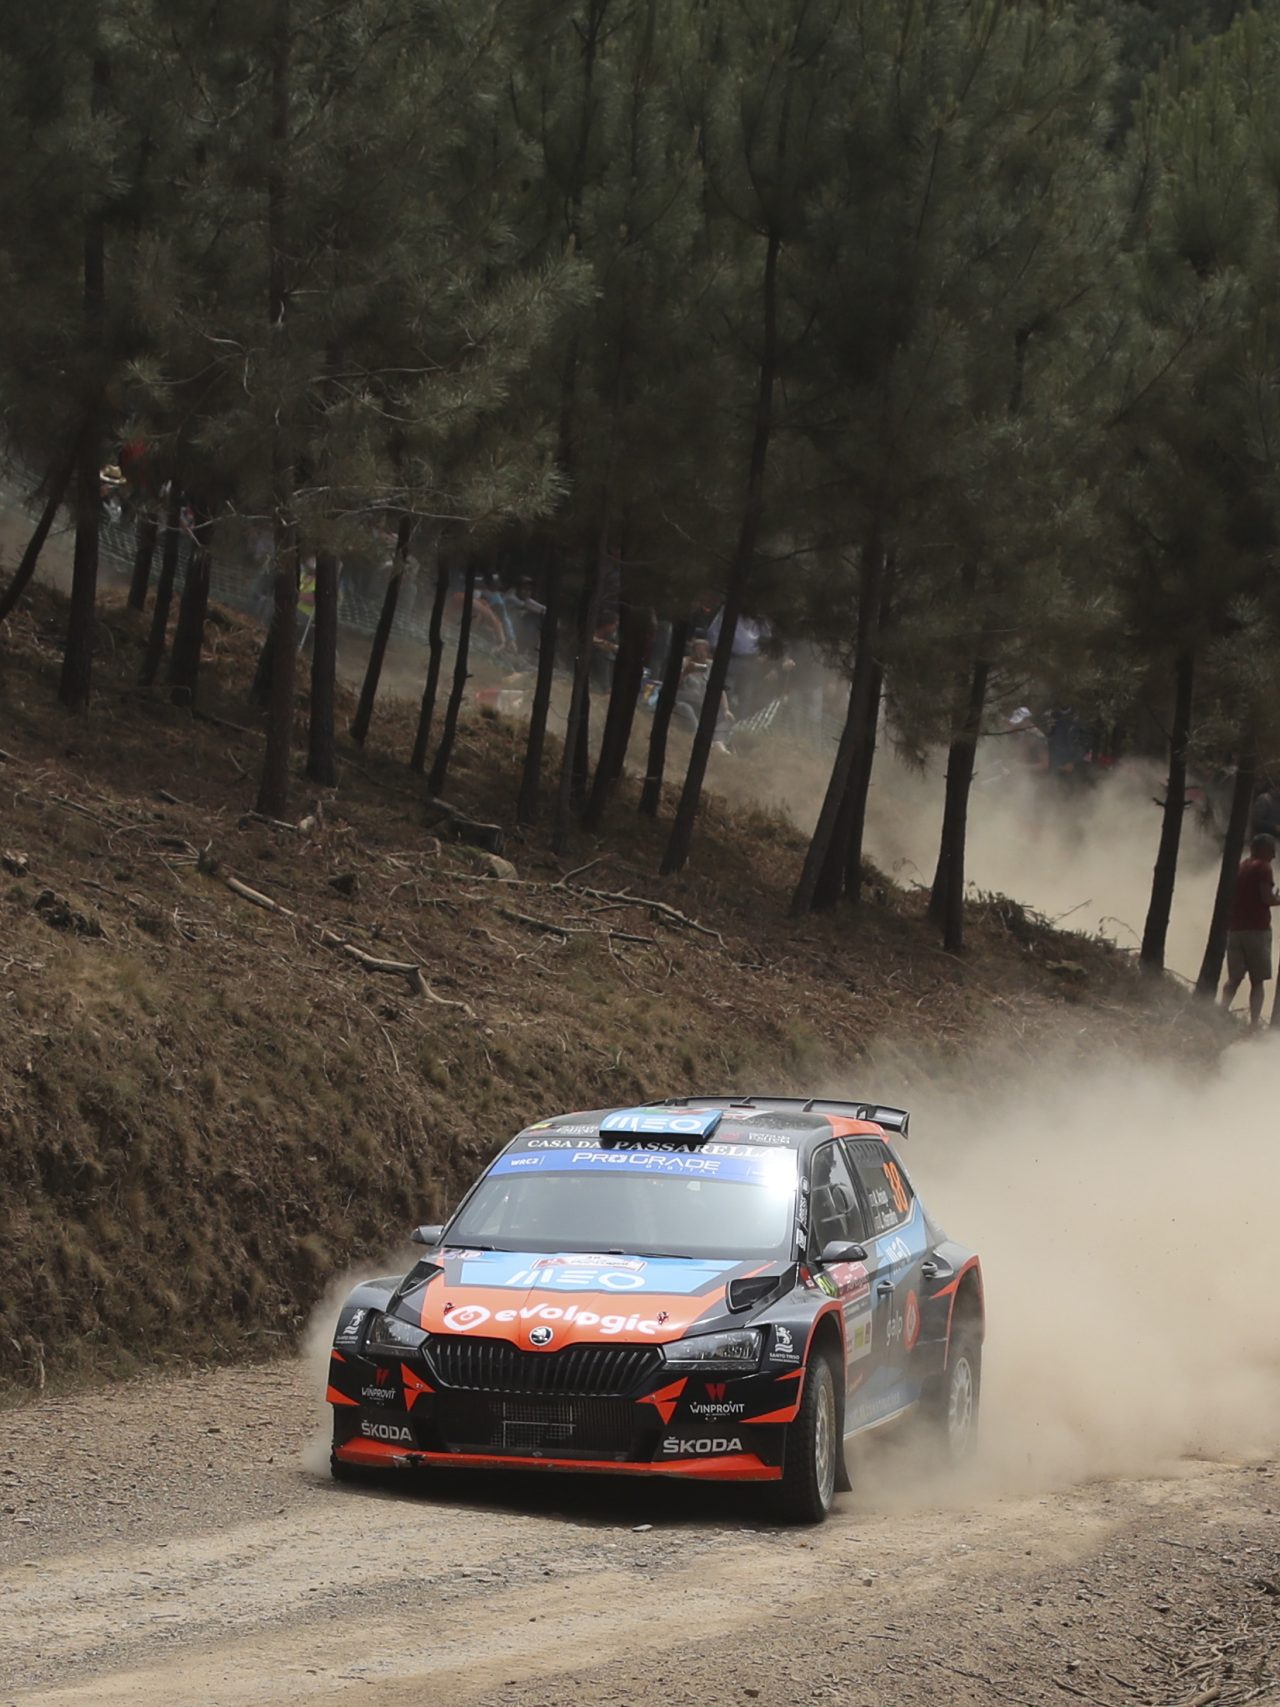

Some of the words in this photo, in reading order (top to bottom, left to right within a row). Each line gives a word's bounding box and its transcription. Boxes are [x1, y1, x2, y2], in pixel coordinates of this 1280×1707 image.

[606, 1116, 702, 1132] MEO
[527, 1139, 572, 1148] CASA
[575, 1140, 602, 1149] DA
[510, 1157, 539, 1166] WRC2
[645, 1163, 717, 1175] DIGITAL
[882, 1161, 909, 1213] 38
[505, 1268, 646, 1289] MEO
[494, 1302, 663, 1335] evologic
[361, 1385, 397, 1399] WINPROVIT
[689, 1401, 745, 1414] WINPROVIT
[361, 1420, 412, 1441] ŠKODA
[662, 1436, 743, 1453] ŠKODA
